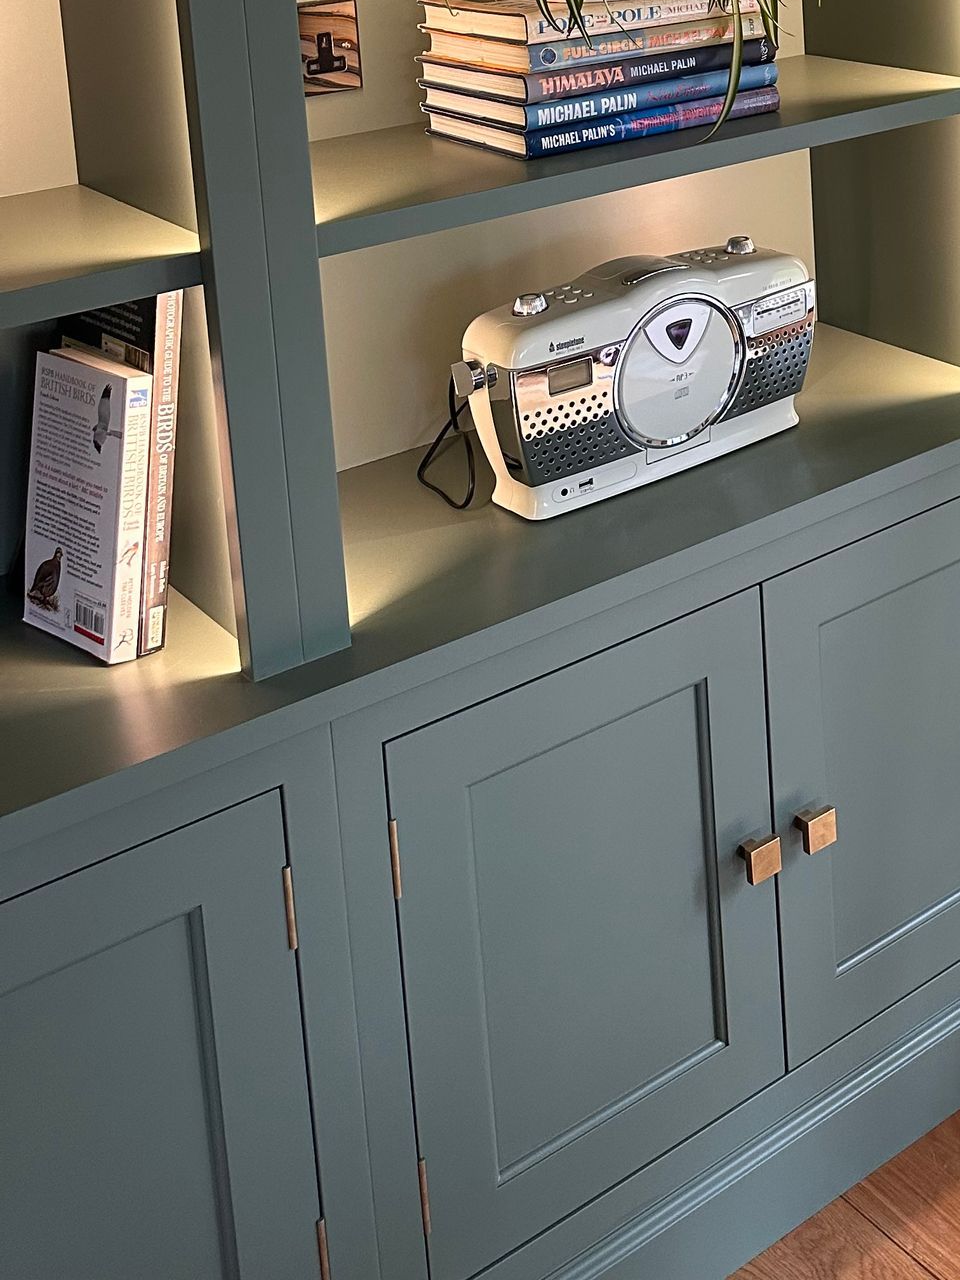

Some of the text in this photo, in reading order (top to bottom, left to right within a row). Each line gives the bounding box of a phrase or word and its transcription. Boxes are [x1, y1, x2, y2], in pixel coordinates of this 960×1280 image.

[538, 13, 594, 34] POE
[611, 5, 662, 22] POLE
[667, 2, 709, 16] MICHAE
[562, 44, 598, 61] FULL
[600, 37, 645, 56] CIRCLE
[648, 29, 701, 48] MICHAEL
[539, 57, 696, 95] HIMALAYA MICHAEL PALIN
[538, 99, 597, 126] MICHAEL
[600, 92, 637, 115] PALIN
[541, 132, 581, 150] MICHAEL
[582, 123, 616, 143] PALIN'S
[163, 350, 174, 375] GUIDE
[40, 377, 72, 399] BRITISH
[72, 387, 96, 407] BIRDS
[54, 370, 87, 388] HANDBOOK
[87, 381, 97, 392] OF
[163, 376, 172, 387] TO
[156, 402, 175, 452] BIRDS
[125, 414, 139, 472] BRITISH
[135, 439, 145, 500] HANDBOOK
[159, 453, 168, 466] OF
[158, 466, 168, 495] BRITAIN
[122, 475, 135, 520] BIRDS
[157, 496, 167, 512] AND
